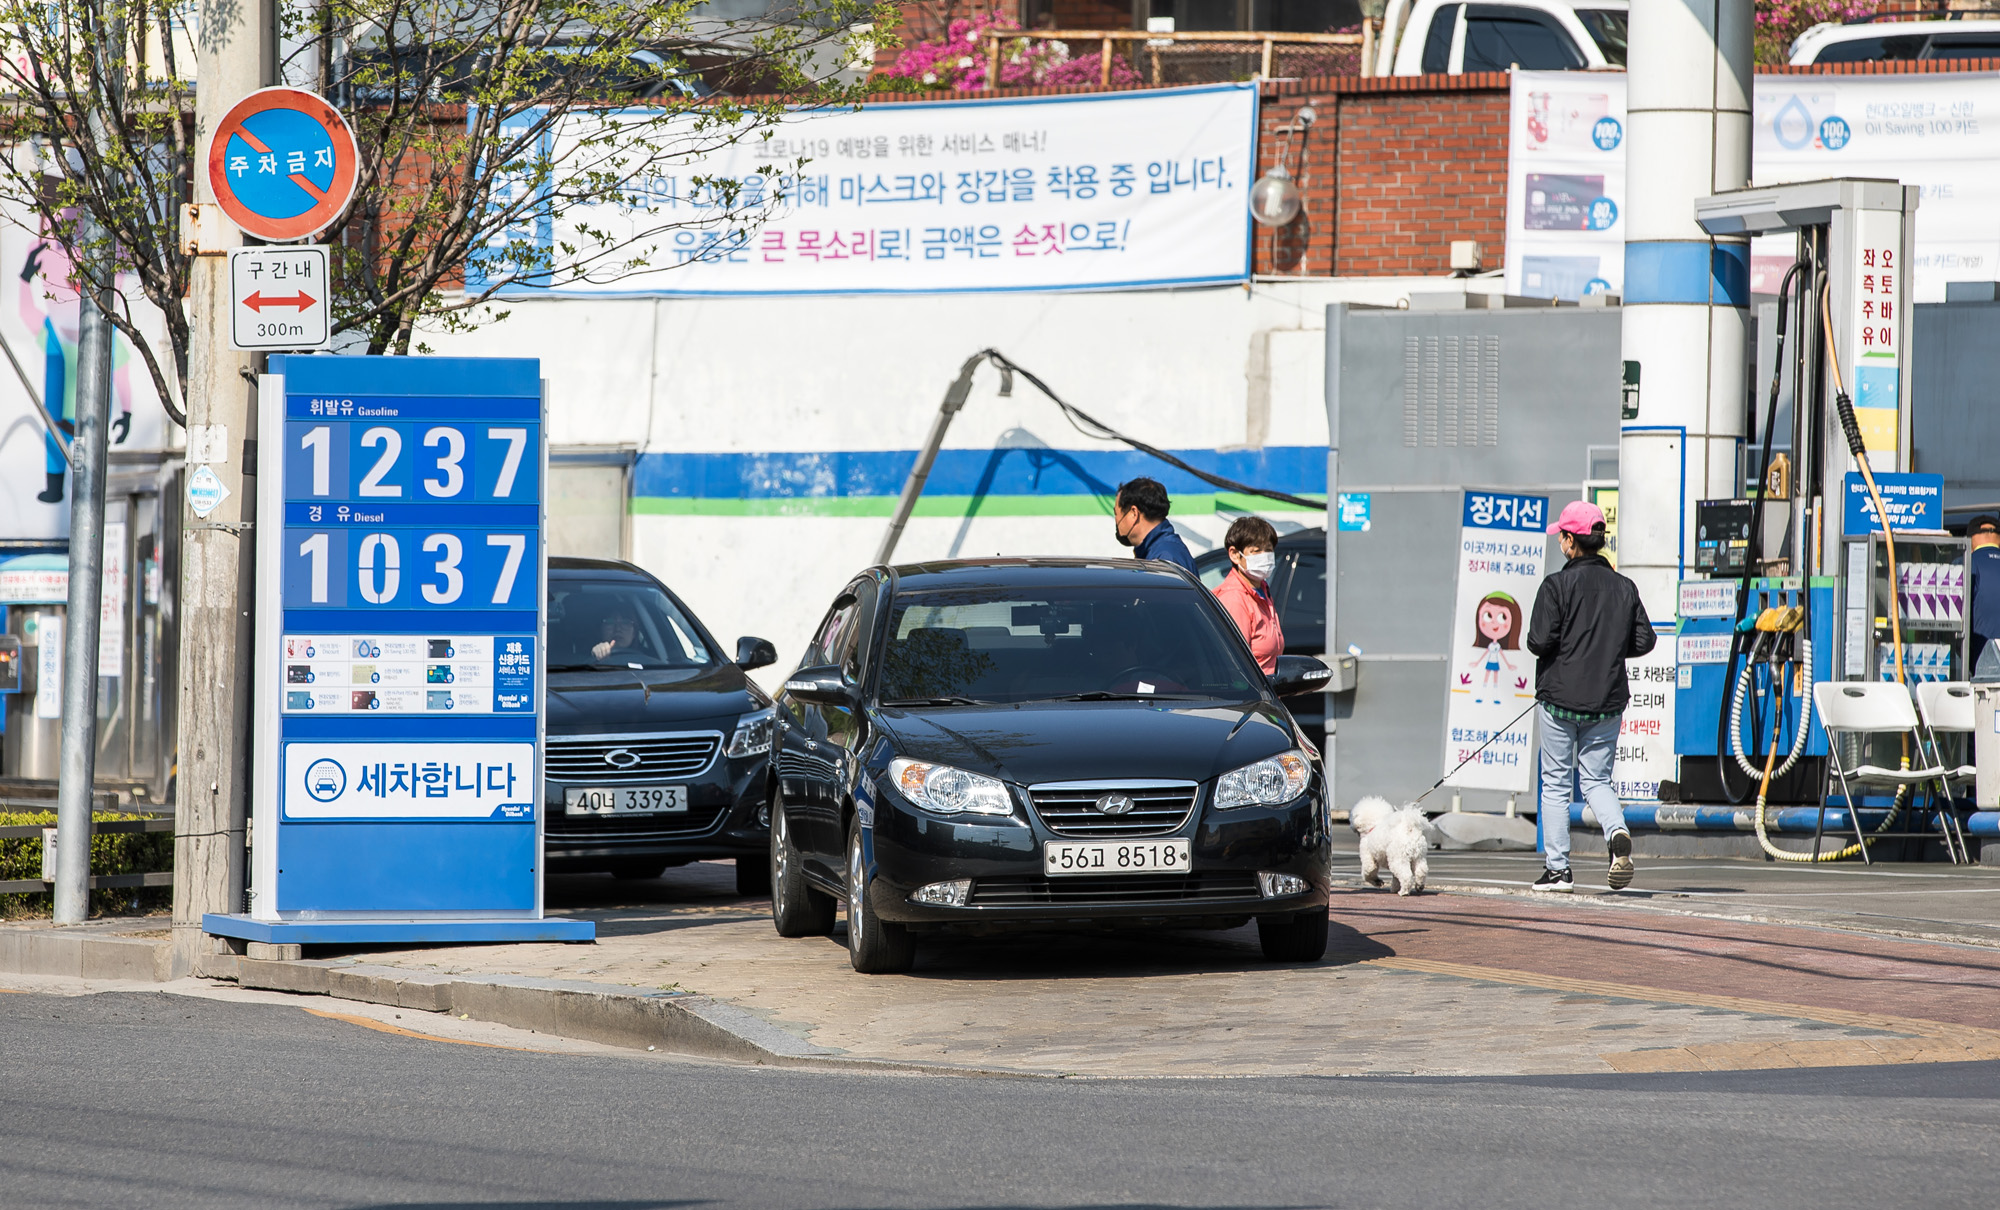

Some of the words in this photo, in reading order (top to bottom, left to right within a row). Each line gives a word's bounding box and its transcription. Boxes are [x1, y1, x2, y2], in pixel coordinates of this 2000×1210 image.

[1865, 121, 1882, 135] Oil
[1885, 121, 1925, 136] Saving
[1929, 120, 1953, 134] 100
[1955, 120, 1980, 136] 카드
[754, 138, 830, 159] 코로나19
[836, 134, 889, 159] 예방을
[898, 134, 933, 157] 위한
[941, 132, 996, 155] 서비스
[1003, 130, 1047, 152] 매너!
[229, 146, 333, 178] 주차금지
[580, 175, 677, 209] 님의
[779, 173, 828, 207] 위해
[840, 171, 946, 207] 마스크와
[957, 167, 1036, 204] 장갑을
[1047, 165, 1100, 199] 착용
[1109, 164, 1136, 197] 중
[1147, 156, 1233, 194] 입니다.
[672, 231, 752, 263] 유종은
[761, 231, 787, 262] 큰
[796, 228, 910, 263] 목소리로!
[922, 225, 1003, 260] 금액은
[1012, 219, 1131, 257] 손짓으로!
[247, 260, 311, 280] 구간내
[1862, 248, 1876, 346] 좌측주유
[1880, 249, 1893, 347] 오토바이
[257, 323, 303, 337] 300m
[310, 399, 354, 416] 휘발유
[358, 406, 399, 417] Gasoline
[301, 426, 527, 498] 1237
[1469, 495, 1543, 529] 정지선
[1860, 496, 1911, 514] XTeer
[354, 512, 384, 523] Diesel
[1463, 541, 1508, 556] 이곳까지
[1510, 544, 1543, 558] 오셔서
[300, 533, 526, 604] 1037
[1468, 559, 1501, 574] 정지해
[1504, 561, 1536, 576] 주세요
[506, 642, 522, 654] 제휴
[498, 654, 531, 665] 신용카드
[498, 666, 516, 674] 서비스
[518, 666, 530, 675] 안내
[1643, 666, 1676, 682] 차량을
[497, 694, 518, 702] Hyundai
[1632, 693, 1665, 709] 드리며
[1629, 719, 1661, 735] 대씩만
[1451, 728, 1489, 743] 협조해
[1492, 731, 1528, 747] 주셔서
[1457, 748, 1519, 767] 감사합니다
[356, 762, 517, 798] 세차합니다
[577, 791, 615, 811] 40너
[625, 789, 677, 809] 3393
[1061, 847, 1105, 868] 56고
[1117, 845, 1176, 867] 8518
